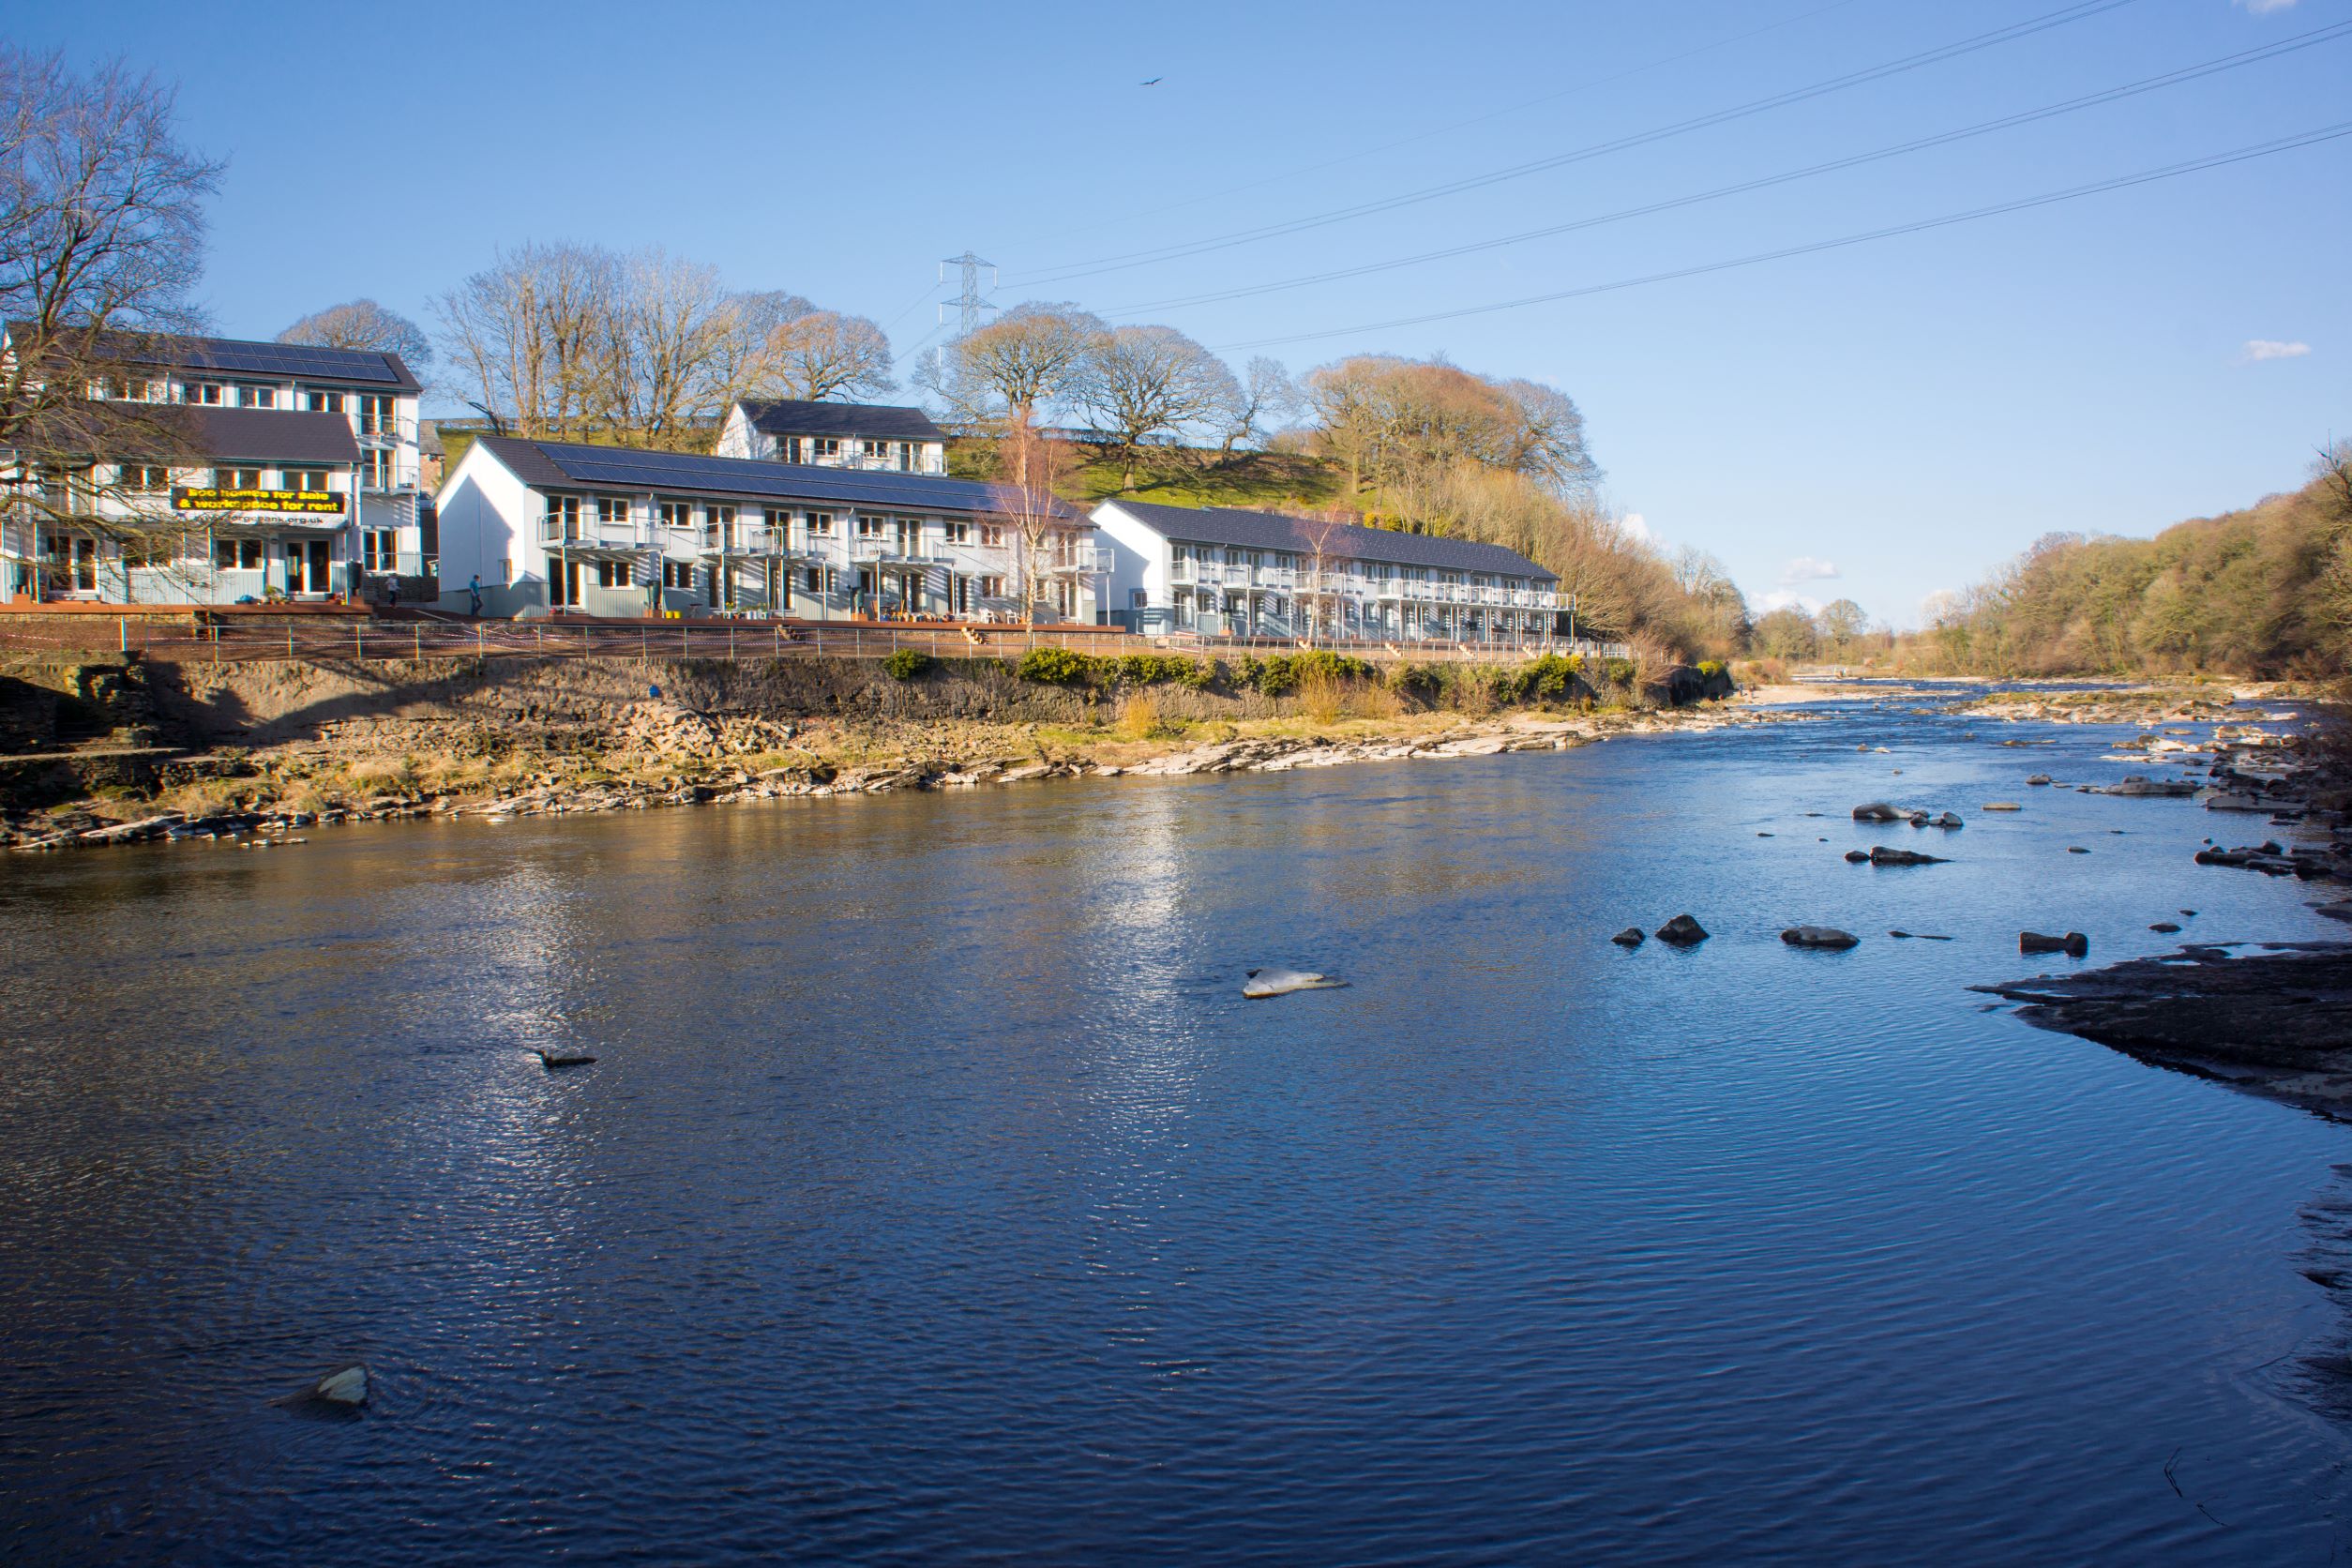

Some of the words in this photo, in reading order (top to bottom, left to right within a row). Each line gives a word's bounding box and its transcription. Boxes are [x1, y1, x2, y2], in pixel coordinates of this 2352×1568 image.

[188, 488, 217, 497] Eco
[219, 490, 270, 498] homes
[273, 490, 295, 500] for
[178, 498, 191, 508] &
[193, 499, 279, 510] workspace
[281, 501, 305, 510] for
[307, 502, 339, 512] rent
